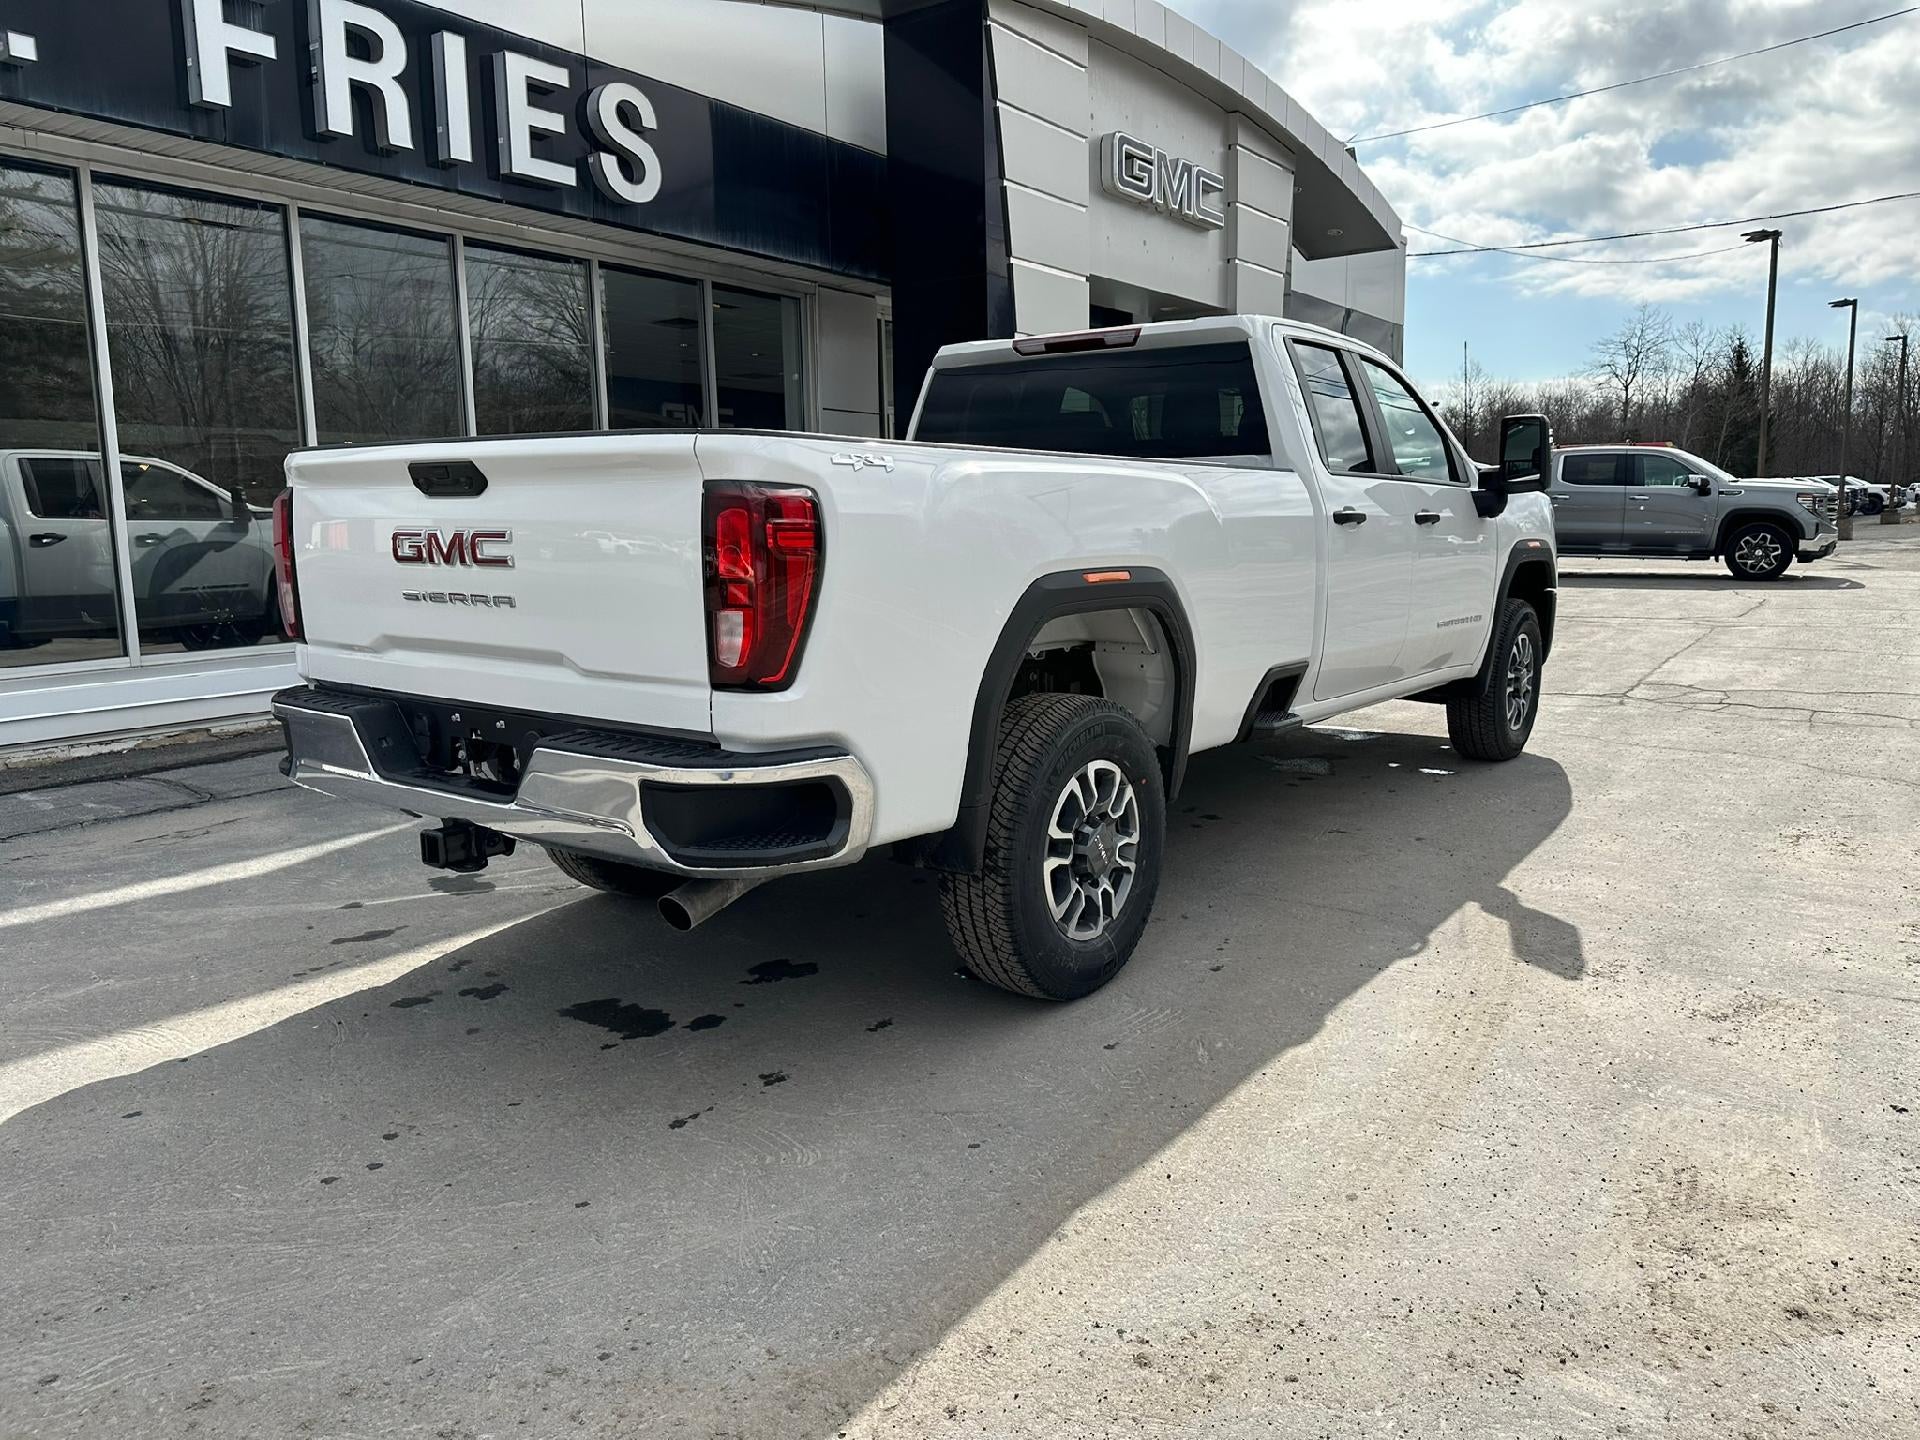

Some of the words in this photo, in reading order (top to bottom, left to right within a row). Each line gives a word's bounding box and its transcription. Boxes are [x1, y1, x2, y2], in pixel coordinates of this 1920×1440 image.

[188, 0, 662, 204] FRIES
[1104, 131, 1224, 229] GMC
[391, 528, 515, 568] GMC
[402, 589, 516, 608] SIERRA
